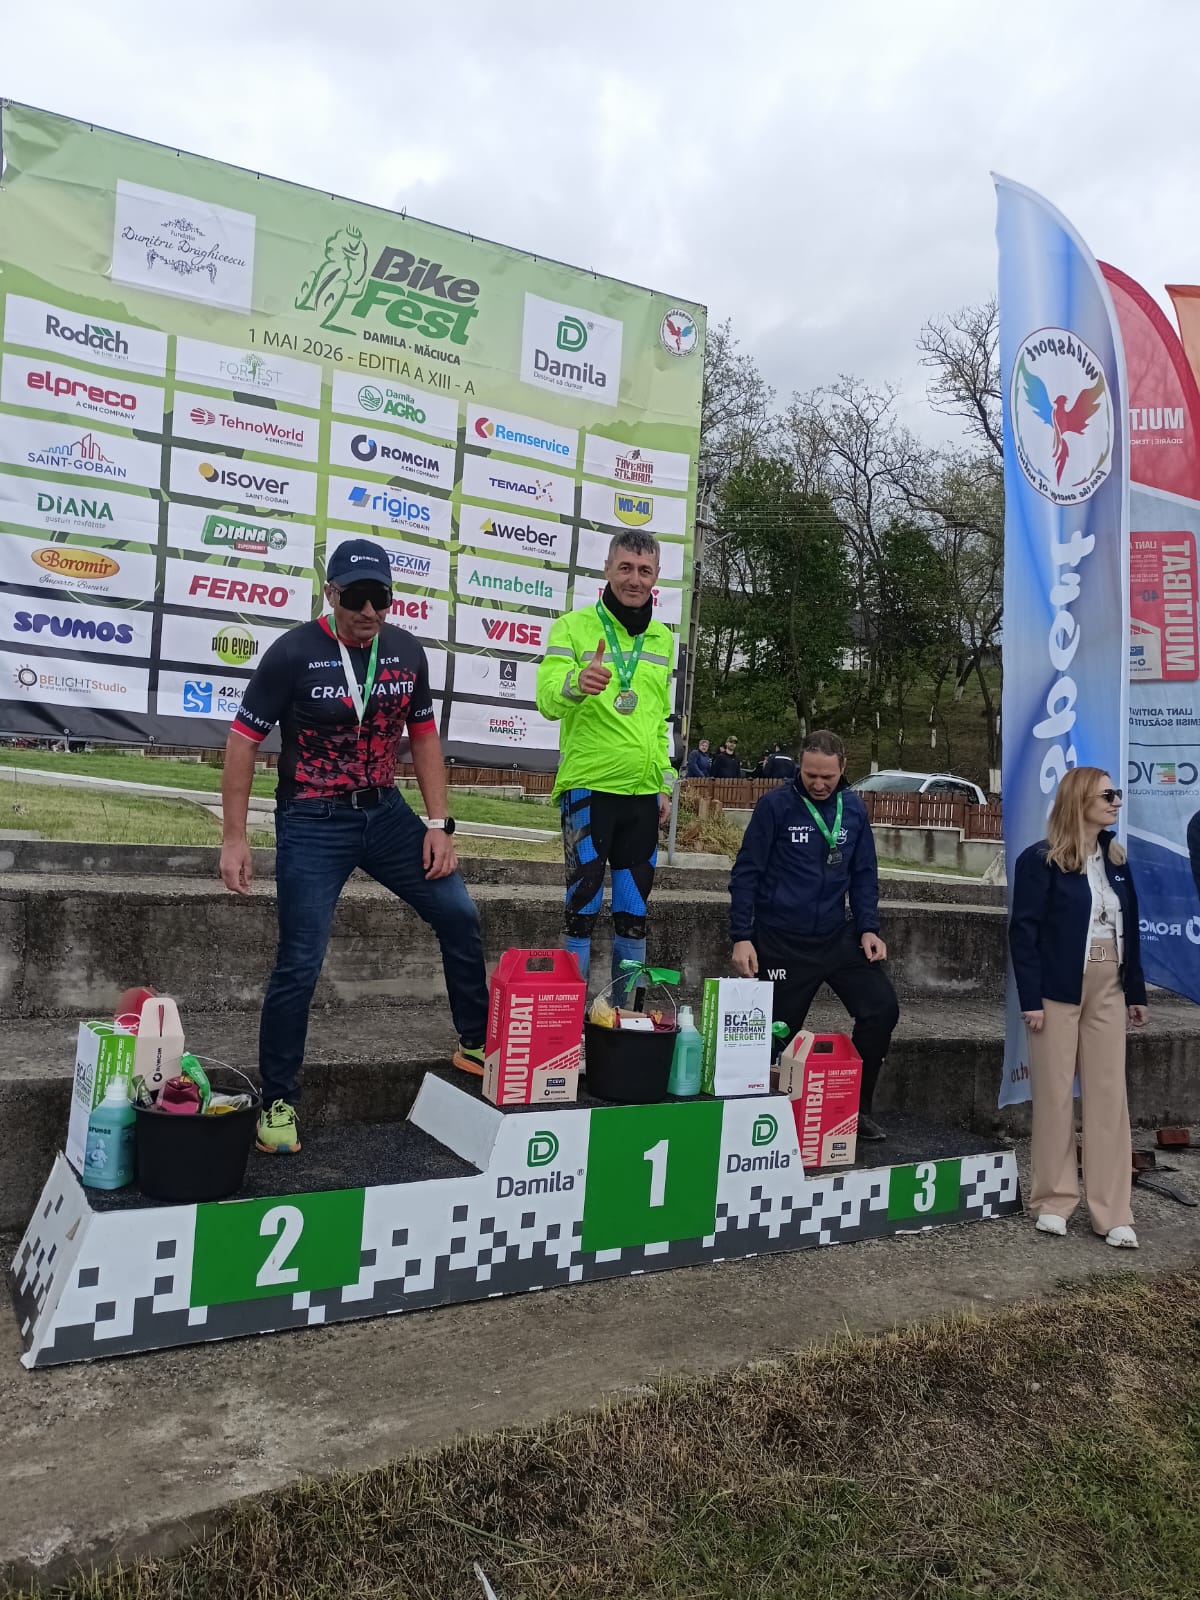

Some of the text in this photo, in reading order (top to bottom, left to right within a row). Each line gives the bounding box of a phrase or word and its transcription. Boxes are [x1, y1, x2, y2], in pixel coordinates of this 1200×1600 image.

[121, 226, 174, 249] Dumitru
[370, 245, 480, 304] Bike
[351, 279, 480, 346] Fest
[46, 313, 128, 355] Rodach
[363, 330, 407, 350] DAMILA
[414, 343, 461, 366] MĂCIUCA
[249, 328, 255, 343] 1
[263, 330, 298, 350] MAI
[302, 338, 343, 361] 2026
[358, 352, 411, 378] EDITIA
[414, 366, 424, 383] A
[428, 370, 451, 390] XIII
[464, 380, 475, 395] A
[534, 348, 607, 388] Damila
[27, 370, 137, 411] elpreco
[385, 388, 415, 404] Damila
[82, 402, 98, 412] CRH
[98, 407, 136, 420] COMPANY
[383, 399, 426, 424] AGRO
[218, 413, 304, 442] TehnoWorld
[495, 424, 570, 456] Remservice
[28, 452, 127, 478] SAINT-GOBAIN
[380, 445, 440, 472] ROMCIM
[245, 491, 289, 505] SAINT-GOBAIN
[489, 477, 537, 495] TEMAD
[372, 492, 431, 522] rigips
[618, 497, 650, 515] WD-40
[213, 523, 267, 542] DIANA
[391, 517, 430, 532] SAINT-GOBAIN
[497, 523, 558, 547] weber
[40, 549, 113, 576] Boromir
[386, 552, 431, 572] DEXIM
[188, 575, 289, 608] FERRO
[468, 569, 553, 599] Annabella
[13, 611, 134, 644] SPUMOS
[481, 618, 542, 646] WISE
[211, 635, 259, 656] pro event
[390, 681, 414, 695] MTB
[217, 698, 239, 713] Re
[489, 718, 515, 728] EURO
[489, 725, 524, 735] MARKET
[791, 832, 809, 843] LH
[767, 968, 787, 981] WR
[724, 1014, 748, 1027] BCA
[724, 1026, 766, 1034] PERFORMANT
[502, 993, 533, 1105] MULTIBAT
[724, 1033, 766, 1041] ENERGETIC
[802, 1070, 825, 1166] MULTIBAT
[643, 1139, 669, 1208] 1
[726, 1149, 791, 1174] Damila
[496, 1171, 575, 1199] Damila
[913, 1162, 937, 1212] 3
[255, 1205, 304, 1287] 2
